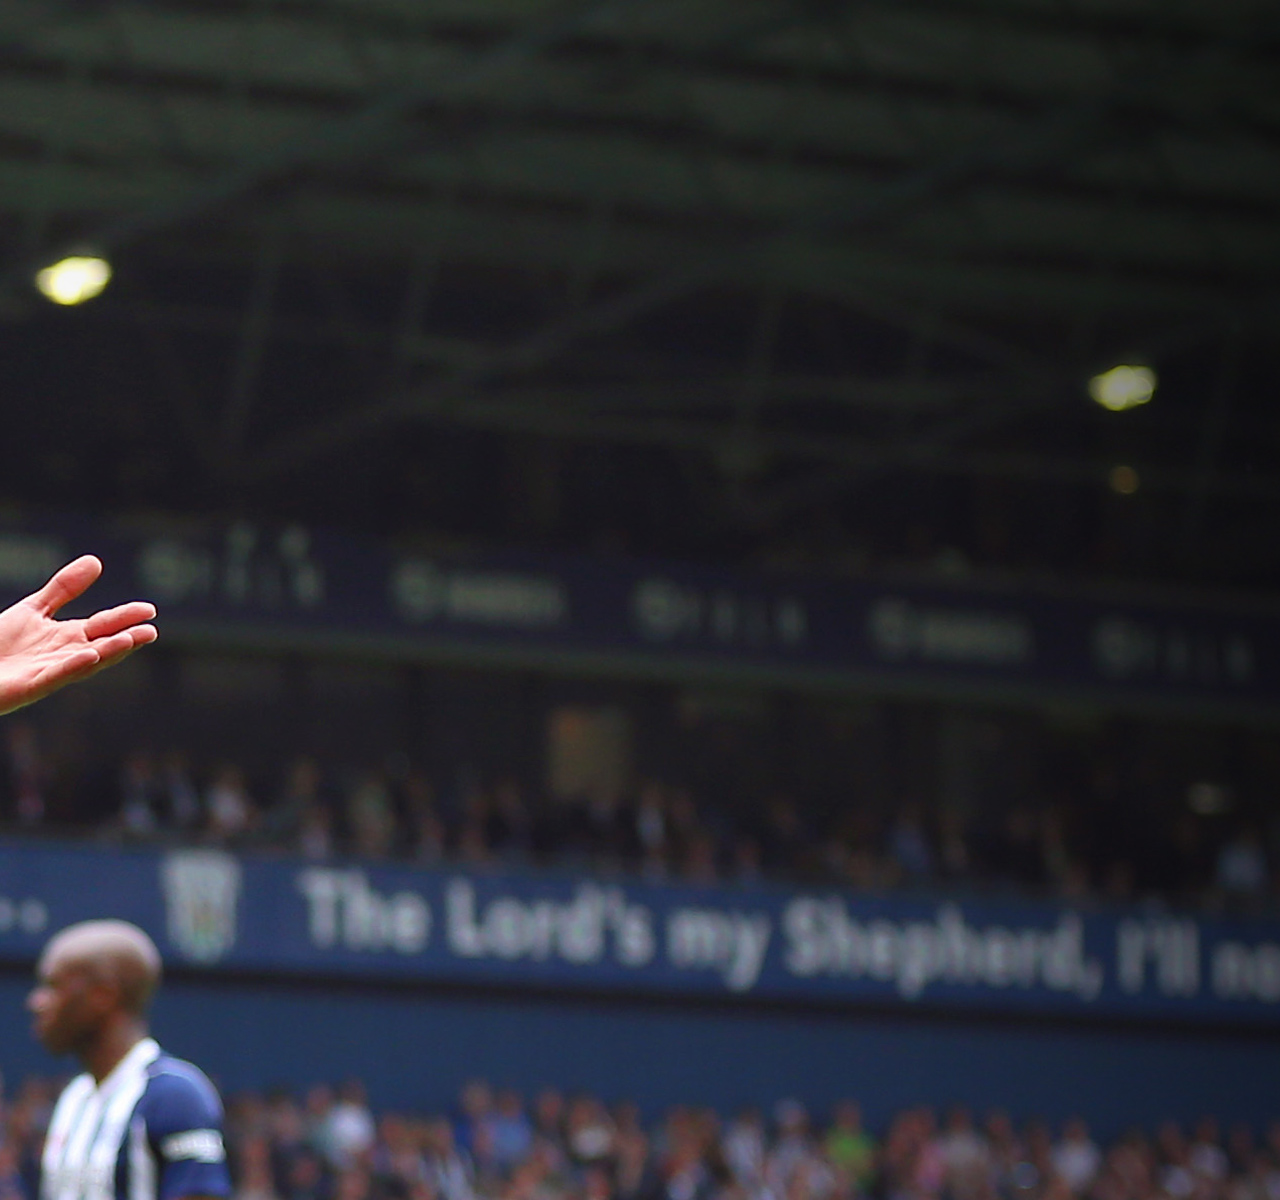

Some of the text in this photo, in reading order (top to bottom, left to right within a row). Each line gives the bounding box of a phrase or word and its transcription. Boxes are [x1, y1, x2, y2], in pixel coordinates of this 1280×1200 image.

[298, 864, 432, 954] The
[443, 876, 654, 966] Lord's
[666, 906, 773, 992] my
[783, 892, 1102, 1000] Shepherd,
